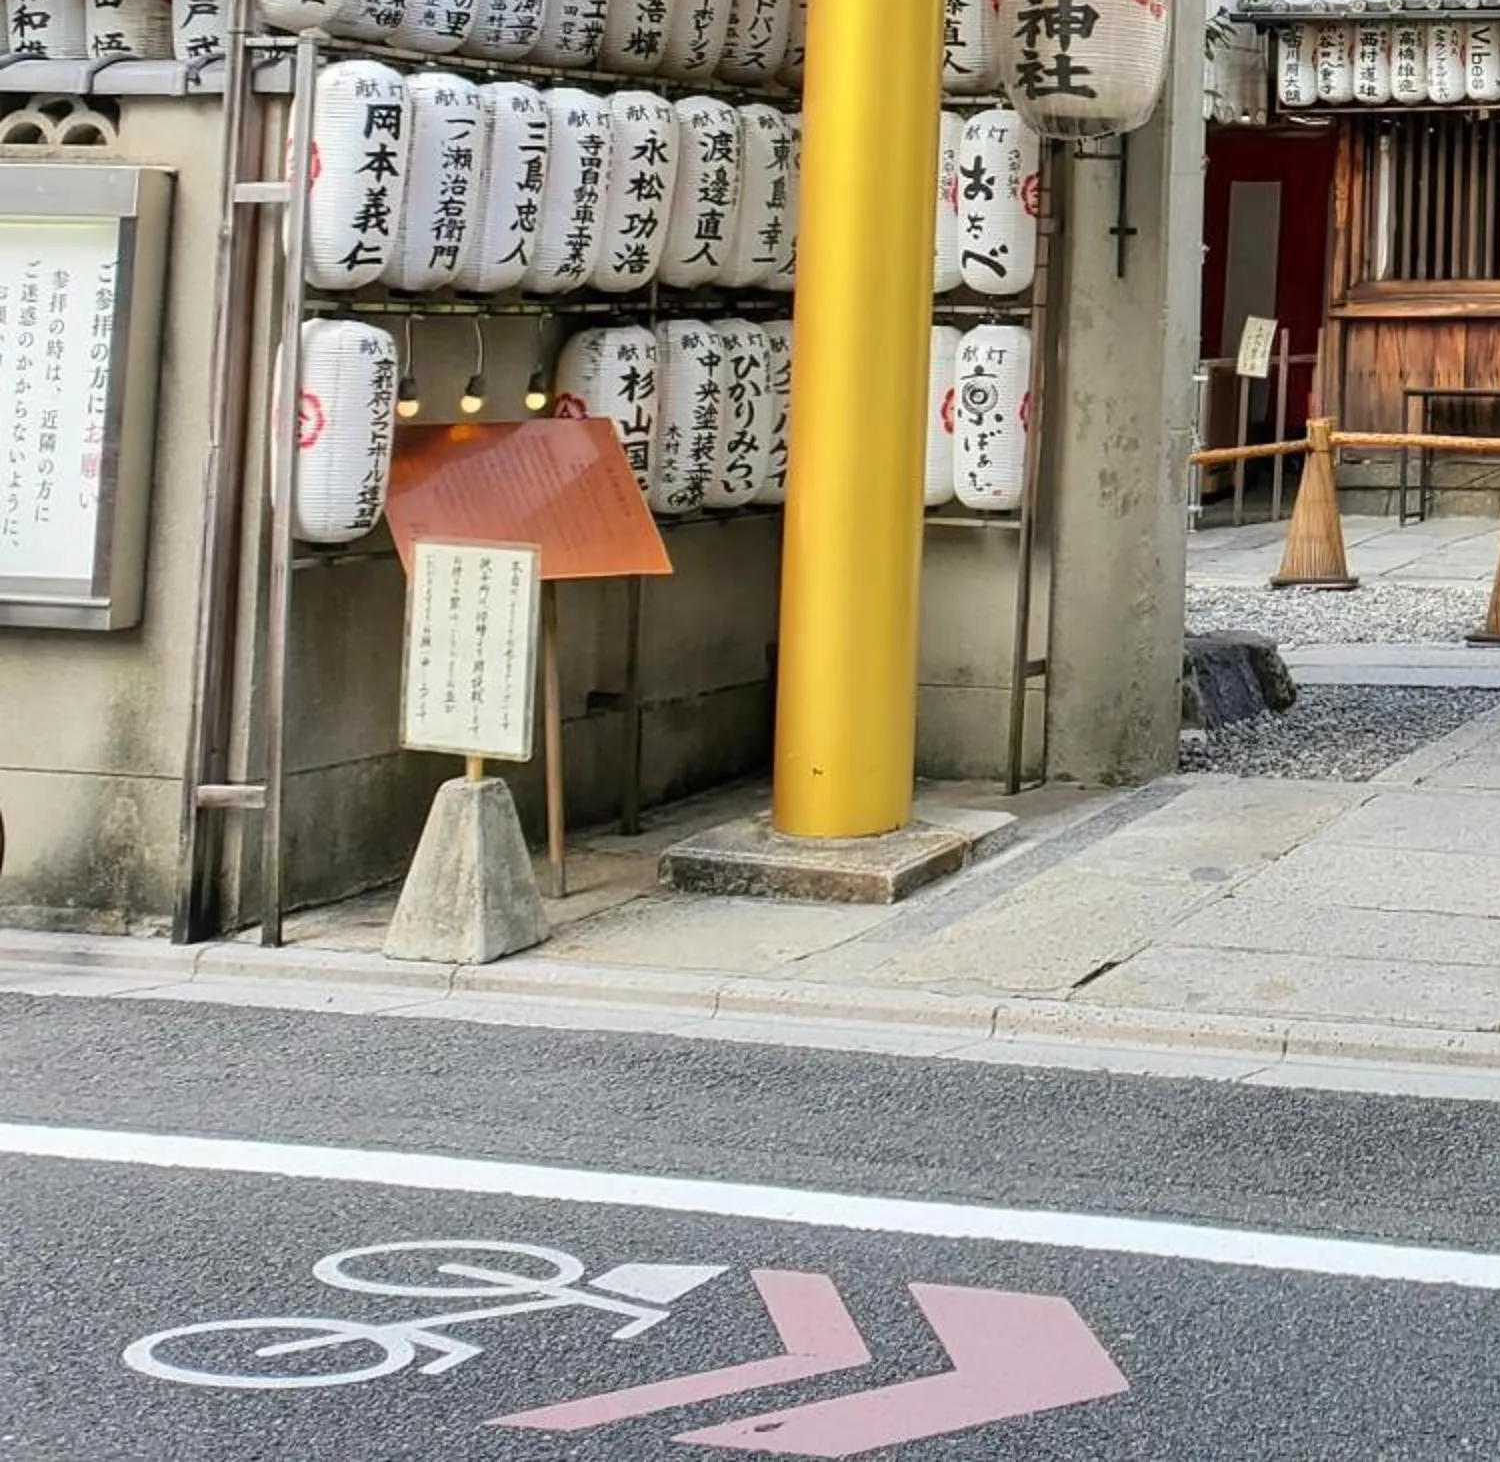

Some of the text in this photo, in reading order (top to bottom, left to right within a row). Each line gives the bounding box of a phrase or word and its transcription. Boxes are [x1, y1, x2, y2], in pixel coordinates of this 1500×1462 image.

[434, 89, 481, 111] 献灯
[626, 104, 672, 123] 献灯
[691, 109, 737, 130] 献灯
[336, 103, 402, 272] 岡本義仁
[497, 121, 547, 267] 三島忠人
[553, 134, 605, 279] 寺田自動車工業所
[752, 133, 791, 264] 東島幸一
[721, 353, 761, 492] ひかりみらい
